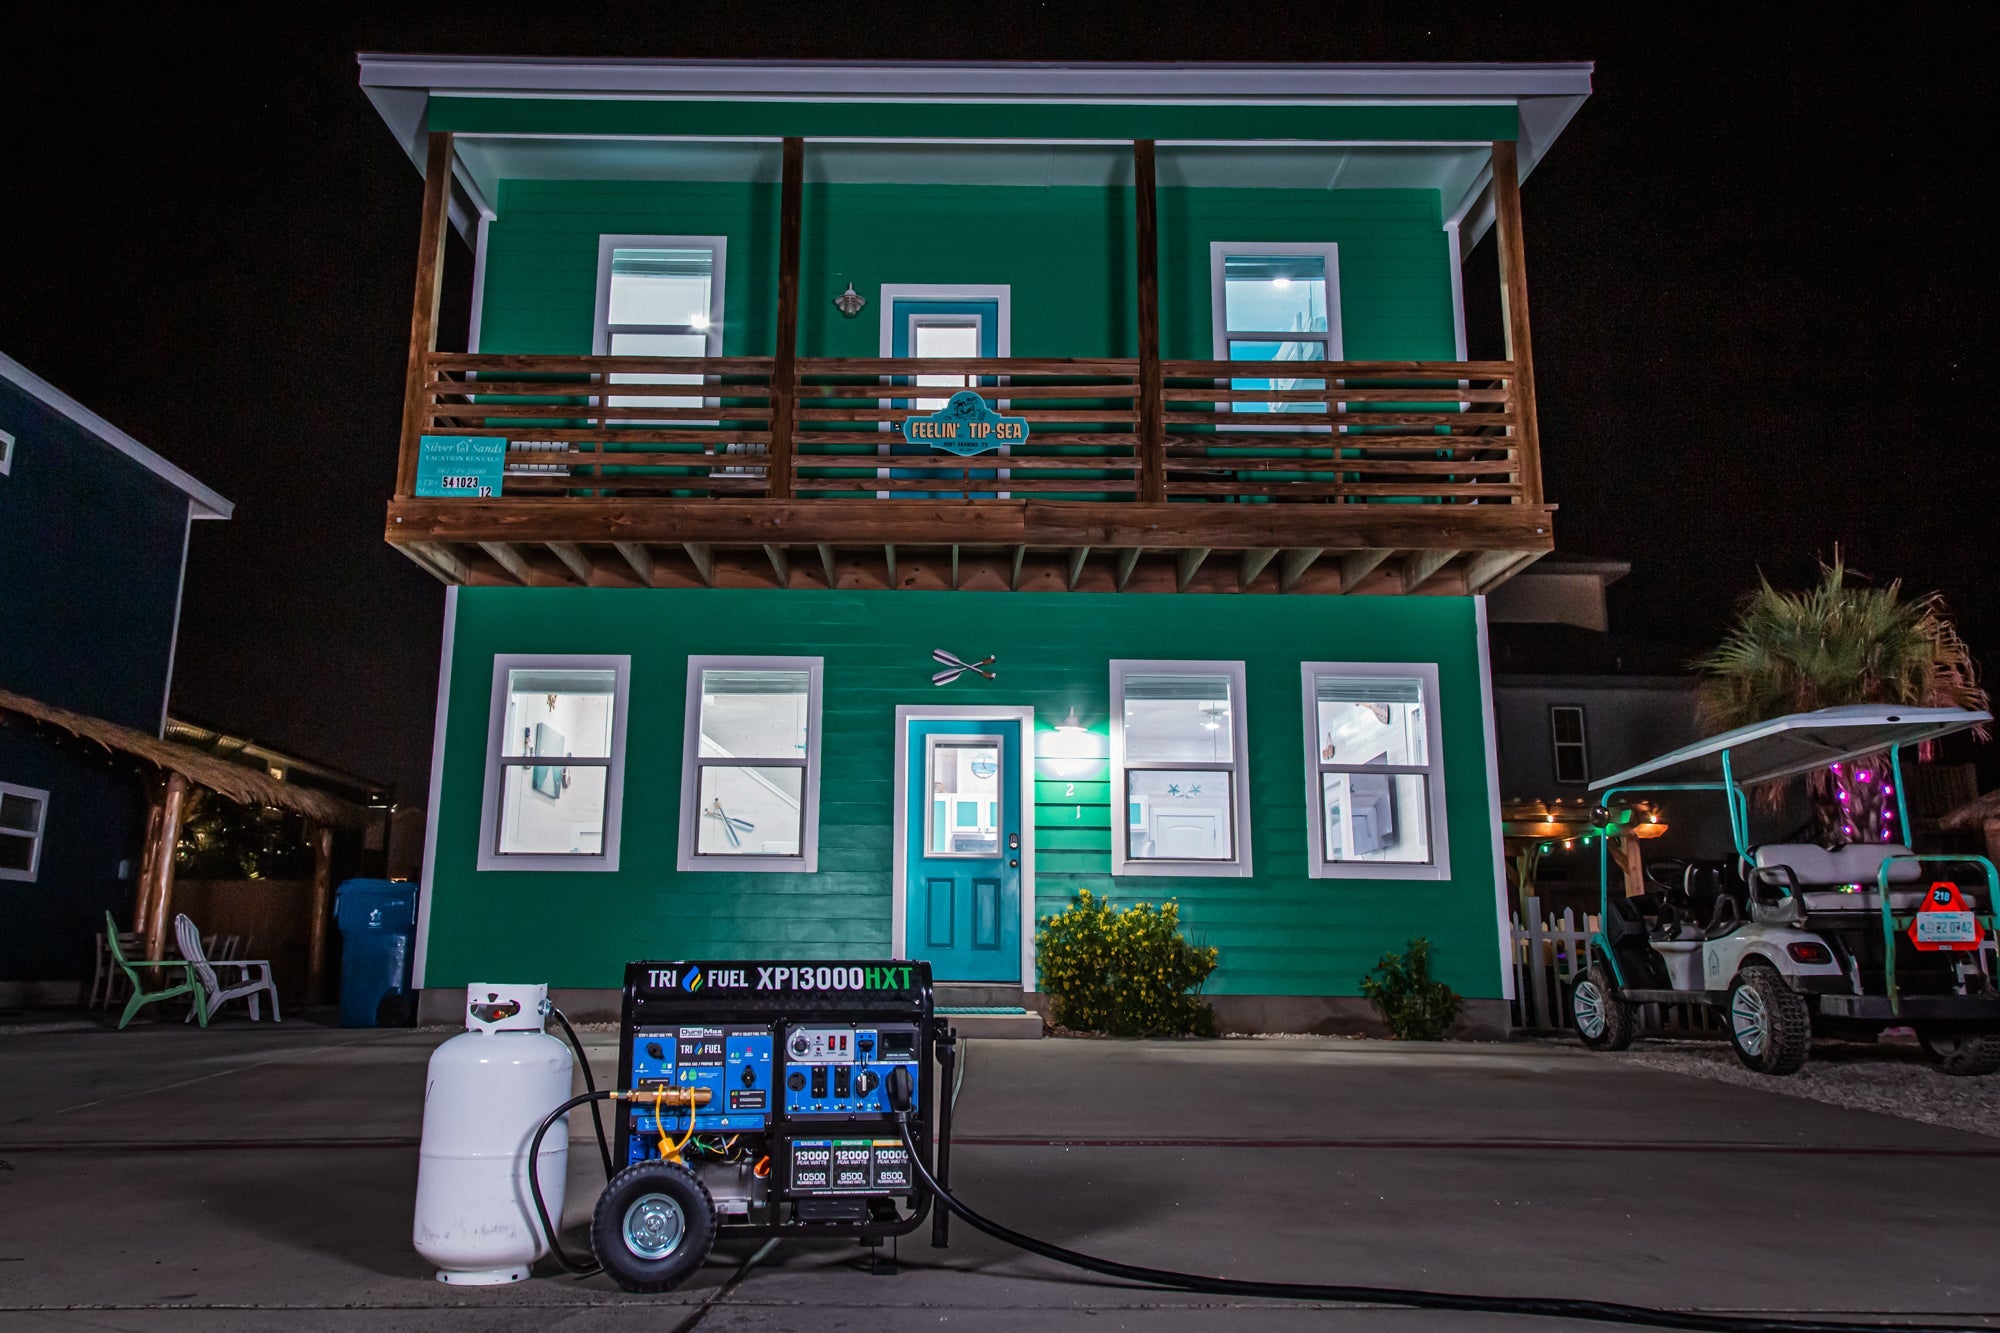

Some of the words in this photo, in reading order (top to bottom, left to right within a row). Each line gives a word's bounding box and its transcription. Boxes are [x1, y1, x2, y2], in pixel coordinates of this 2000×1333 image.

[912, 422, 960, 438] FEELIN'
[968, 422, 1022, 438] TIP-SEA
[424, 442, 454, 452] Silver
[473, 443, 502, 453] Sands
[443, 477, 478, 488] 541023
[481, 487, 491, 497] 12
[1065, 783, 1074, 797] 2
[649, 970, 676, 988] TRI
[708, 970, 748, 987] FUEL
[757, 967, 913, 990] XP13000HXT
[681, 1045, 692, 1054] TRI
[705, 1044, 721, 1053] FUEL
[796, 1151, 829, 1160] 13000
[836, 1151, 869, 1160] 12000
[876, 1150, 909, 1159] 10000
